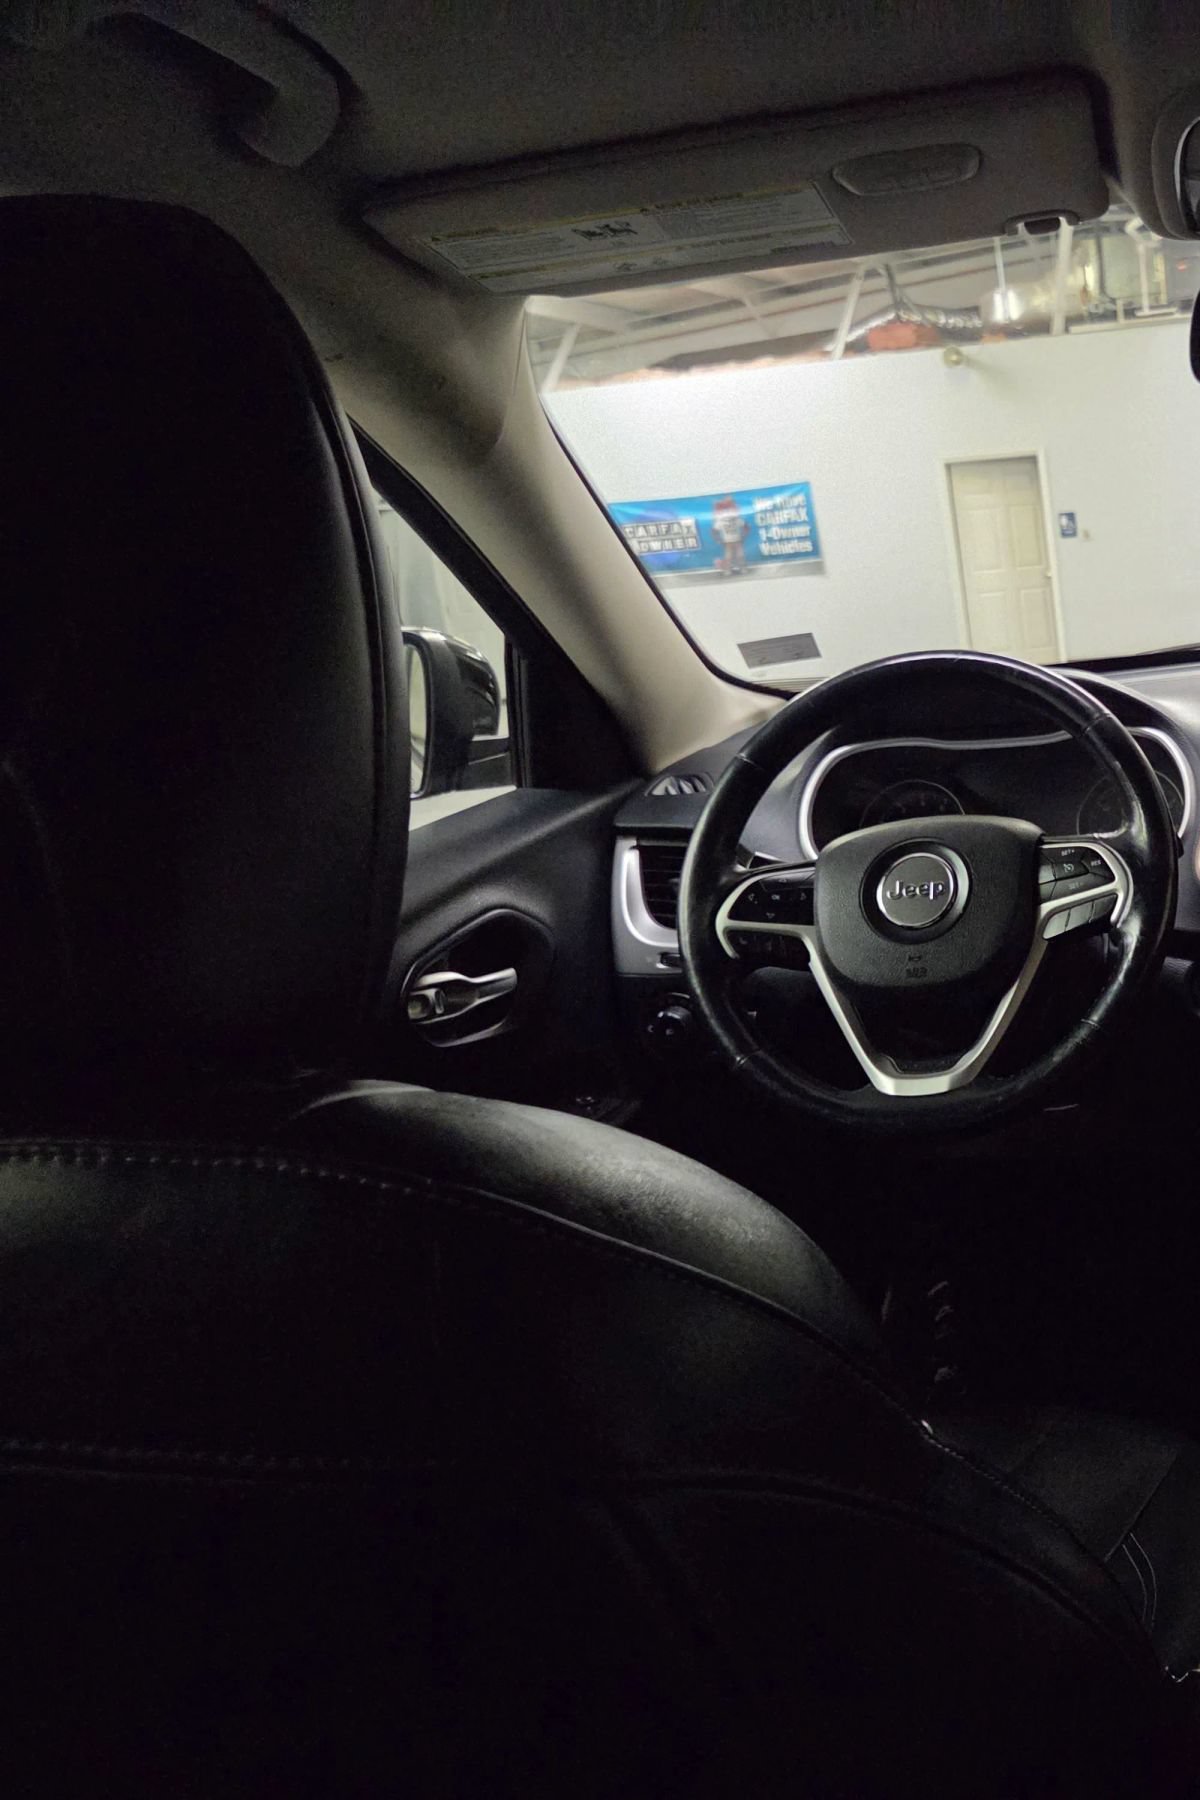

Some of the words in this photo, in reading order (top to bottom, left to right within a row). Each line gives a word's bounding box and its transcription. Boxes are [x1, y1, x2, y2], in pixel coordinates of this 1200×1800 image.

[756, 508, 808, 526] CARFAX
[623, 519, 697, 538] CARFAX
[886, 880, 944, 900] Jeep
